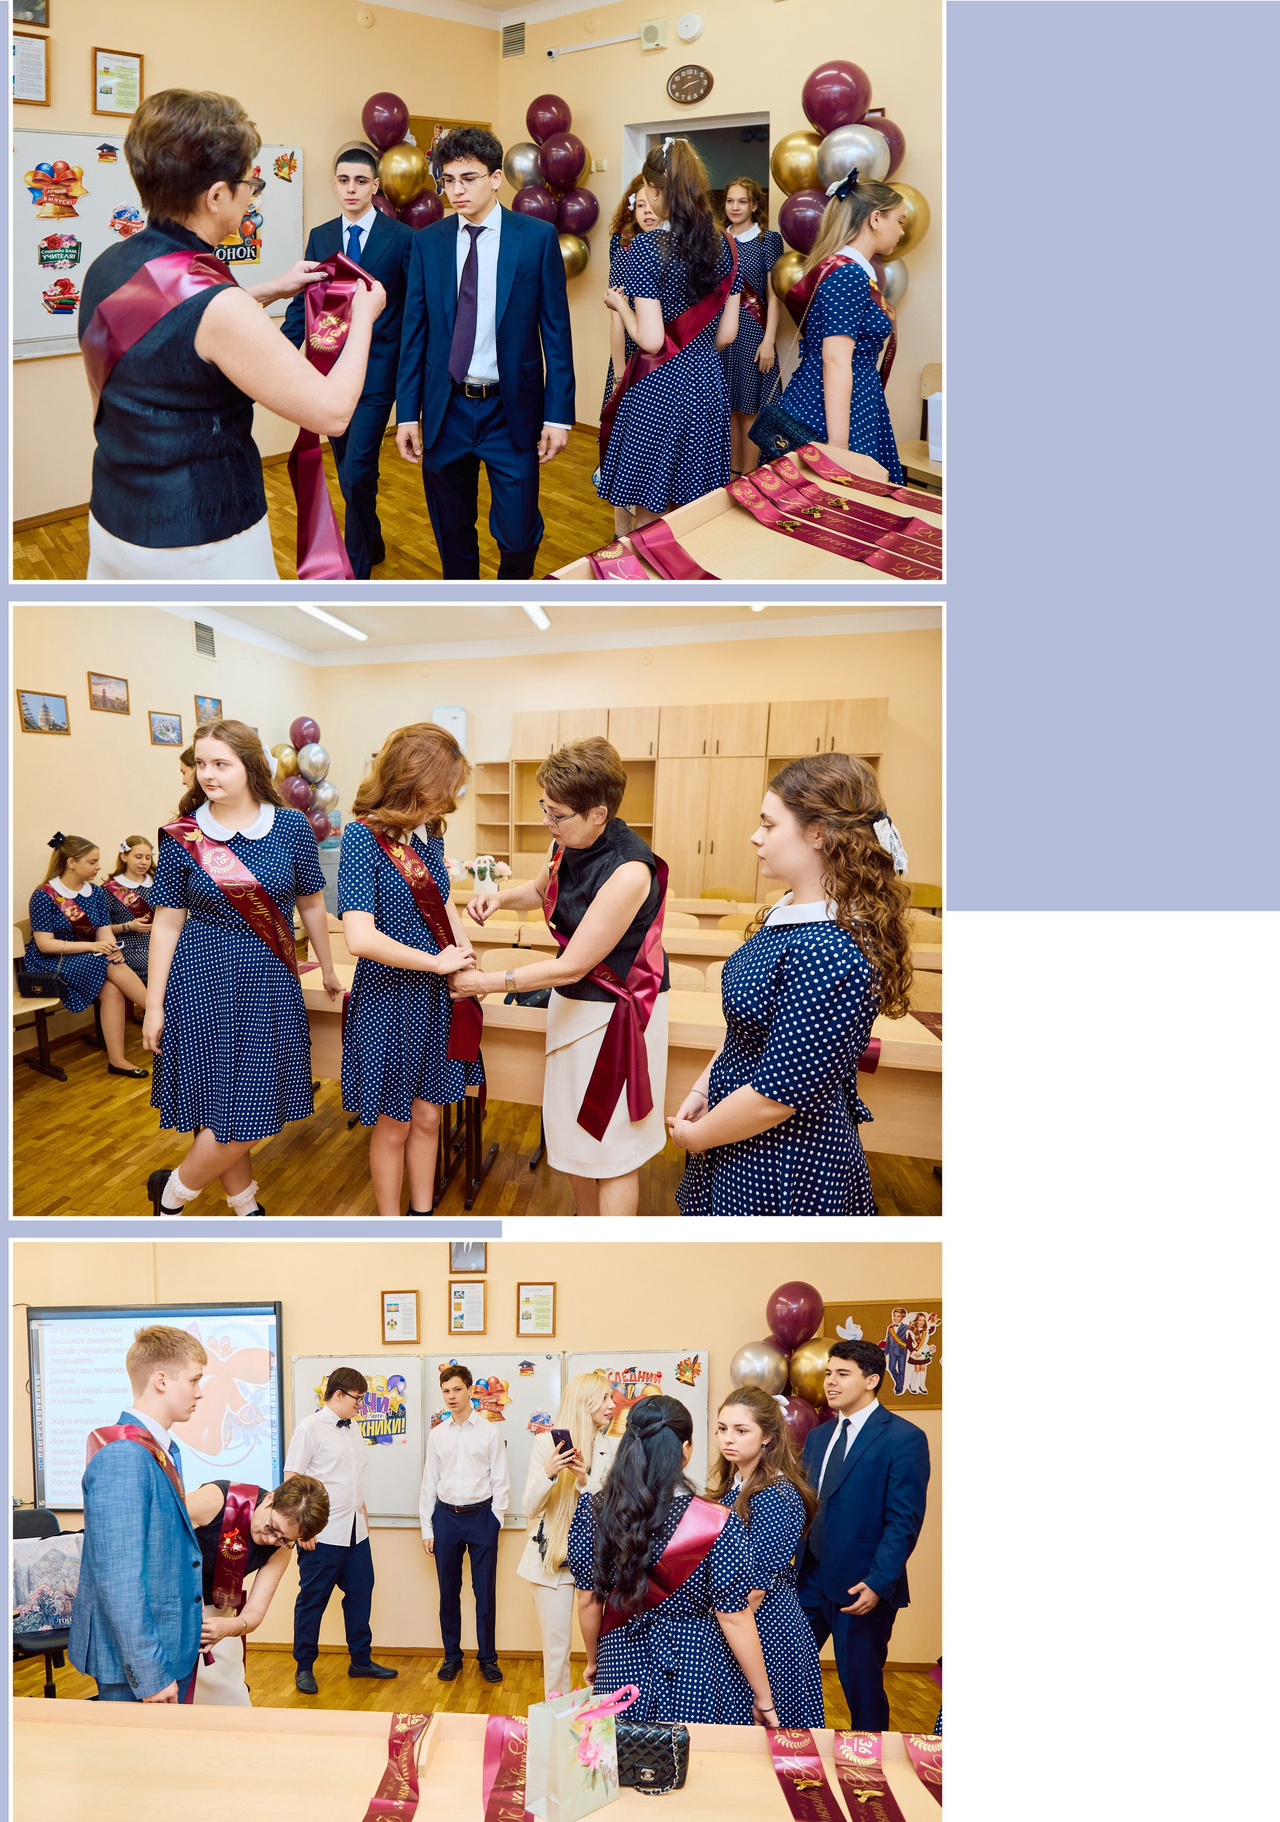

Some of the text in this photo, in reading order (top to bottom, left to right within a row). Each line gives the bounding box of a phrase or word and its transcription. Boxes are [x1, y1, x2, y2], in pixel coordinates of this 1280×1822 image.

[43, 196, 73, 205] ВЫПУСК!
[215, 246, 257, 261] ОНОК
[744, 488, 757, 500] 36
[215, 852, 230, 865] 36
[48, 1347, 76, 1356] Другим
[77, 1347, 112, 1355] ученикам
[48, 1367, 79, 1375] Должны
[93, 1367, 126, 1376] теорему
[607, 1370, 663, 1384] СЛЕДНИЙ
[49, 1387, 81, 1396] Судьбой
[82, 1386, 104, 1394] своей
[359, 1417, 406, 1437] КНИКИ!
[858, 1738, 873, 1755] 36
